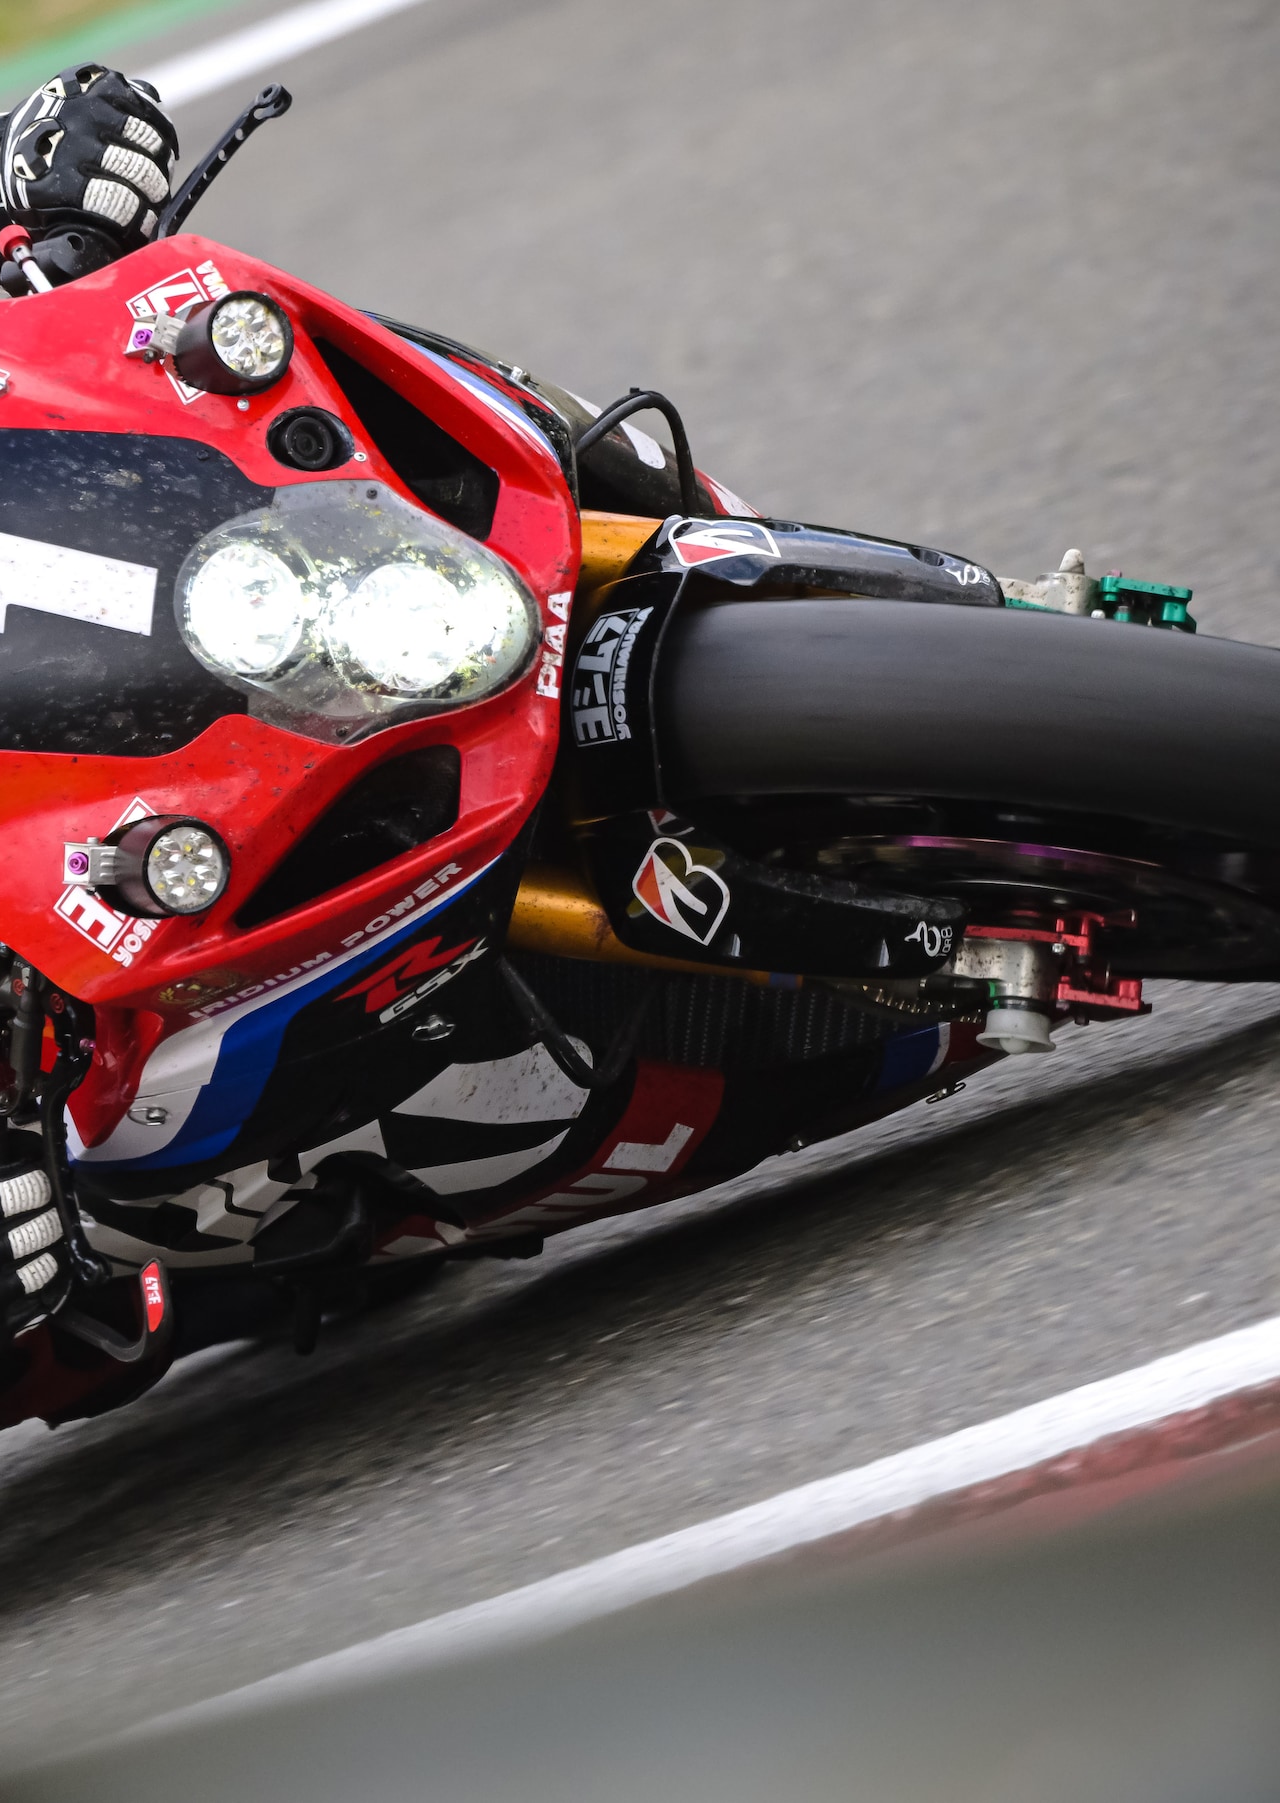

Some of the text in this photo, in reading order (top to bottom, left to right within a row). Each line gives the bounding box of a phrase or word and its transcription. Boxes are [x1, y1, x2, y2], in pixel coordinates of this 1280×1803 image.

[536, 591, 572, 699] PIAA
[612, 606, 655, 741] YOSHIMURA
[188, 862, 463, 1018] IRIDIUM POWER
